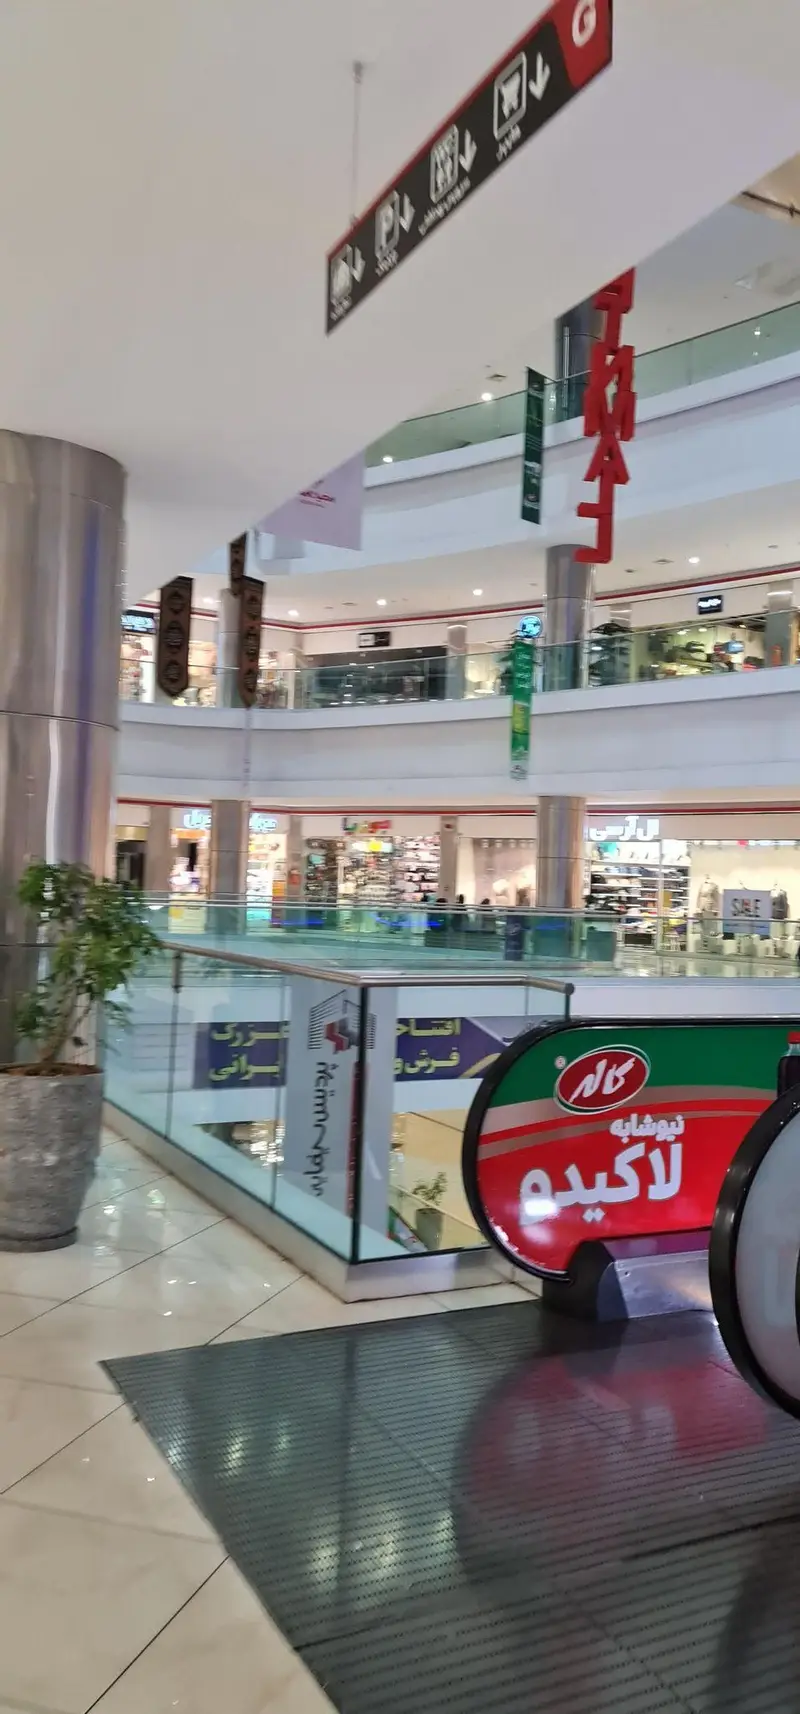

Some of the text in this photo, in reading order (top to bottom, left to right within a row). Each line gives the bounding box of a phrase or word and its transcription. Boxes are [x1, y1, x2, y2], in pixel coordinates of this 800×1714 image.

[572, 0, 597, 47] G
[730, 898, 761, 918] SALE
[312, 1061, 339, 1122] پردیس
[568, 1056, 637, 1104] کاله
[609, 1112, 685, 1144] نیوشابه
[518, 1141, 683, 1226] لاکیدو
